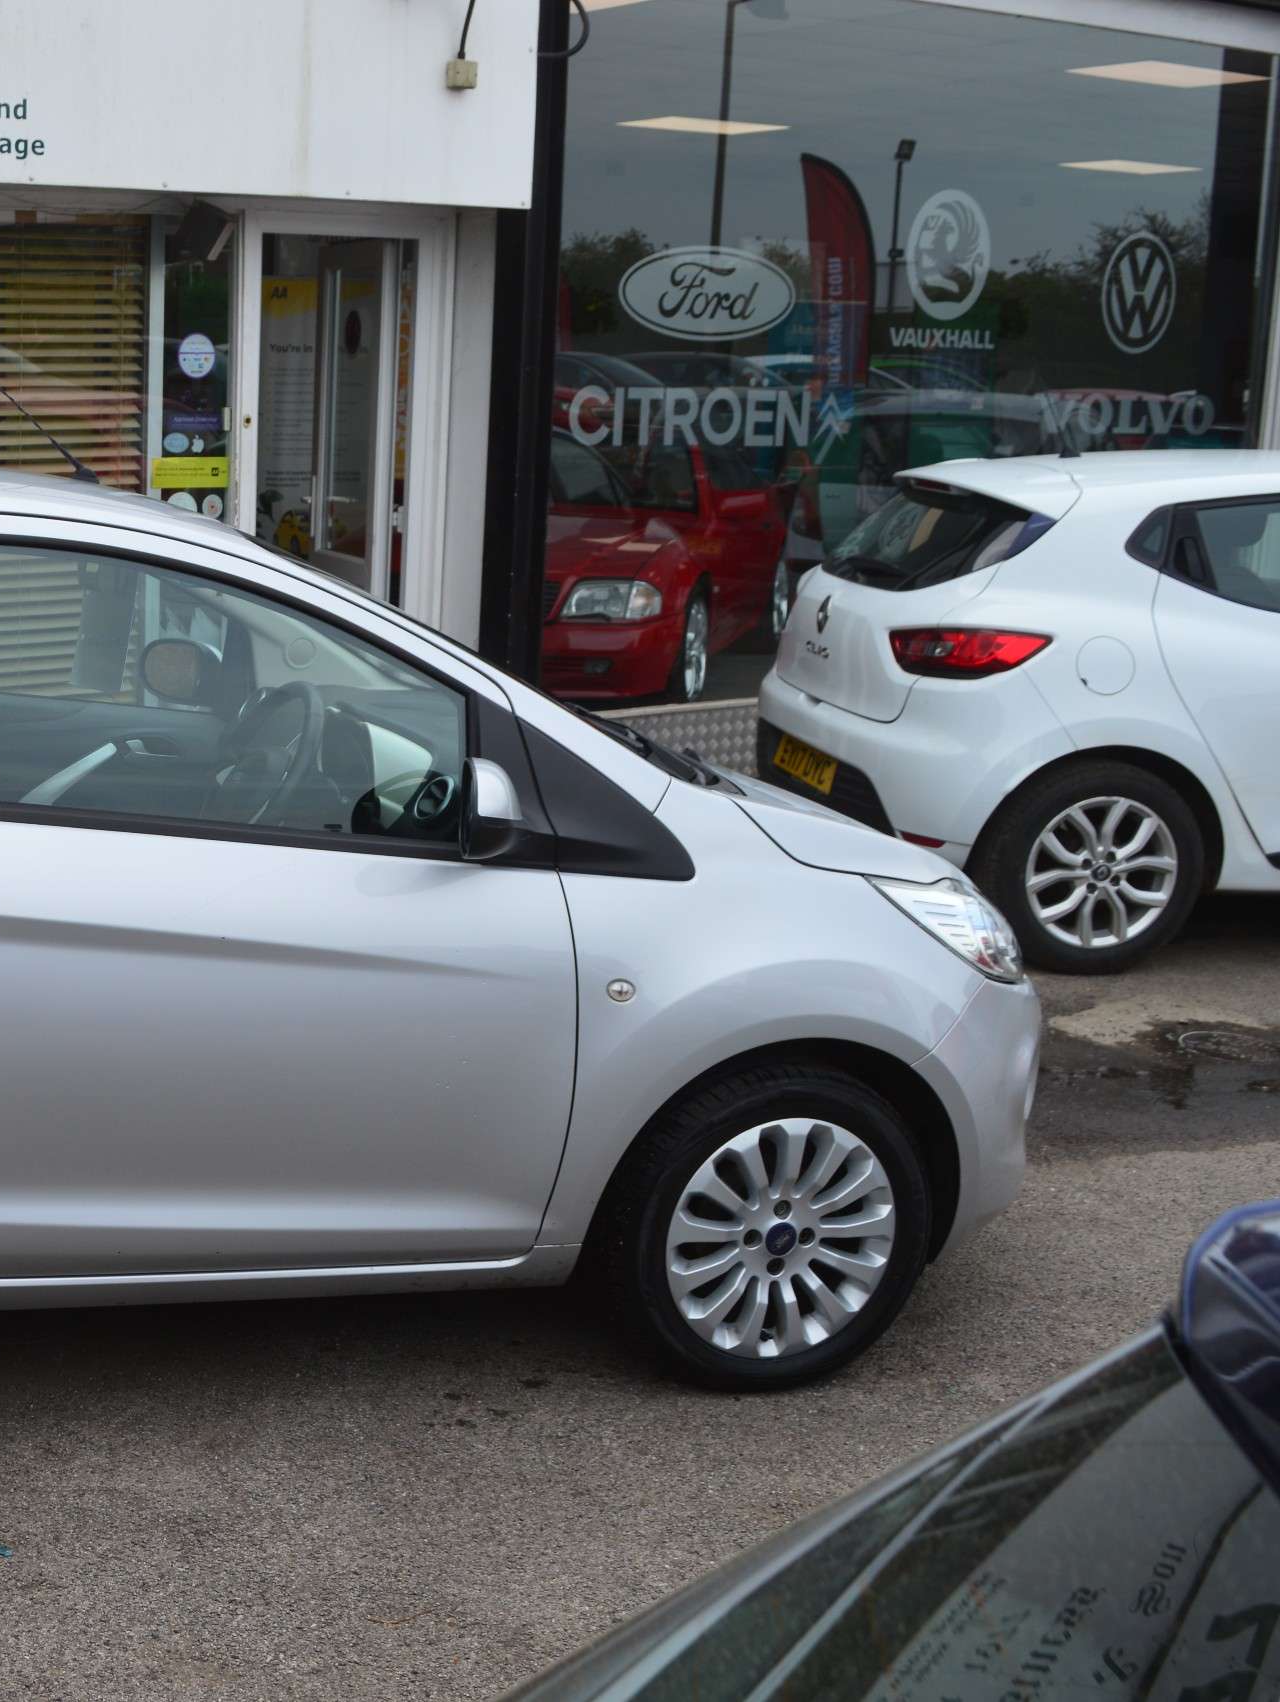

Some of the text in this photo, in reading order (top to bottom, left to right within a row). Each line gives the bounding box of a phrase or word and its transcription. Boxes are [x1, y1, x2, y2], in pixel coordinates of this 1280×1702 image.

[270, 285, 288, 299] AA
[658, 262, 760, 321] Ford
[889, 327, 995, 350] VAUXHALL
[568, 376, 813, 448] CITROËN
[1035, 393, 1215, 436] VOLVO
